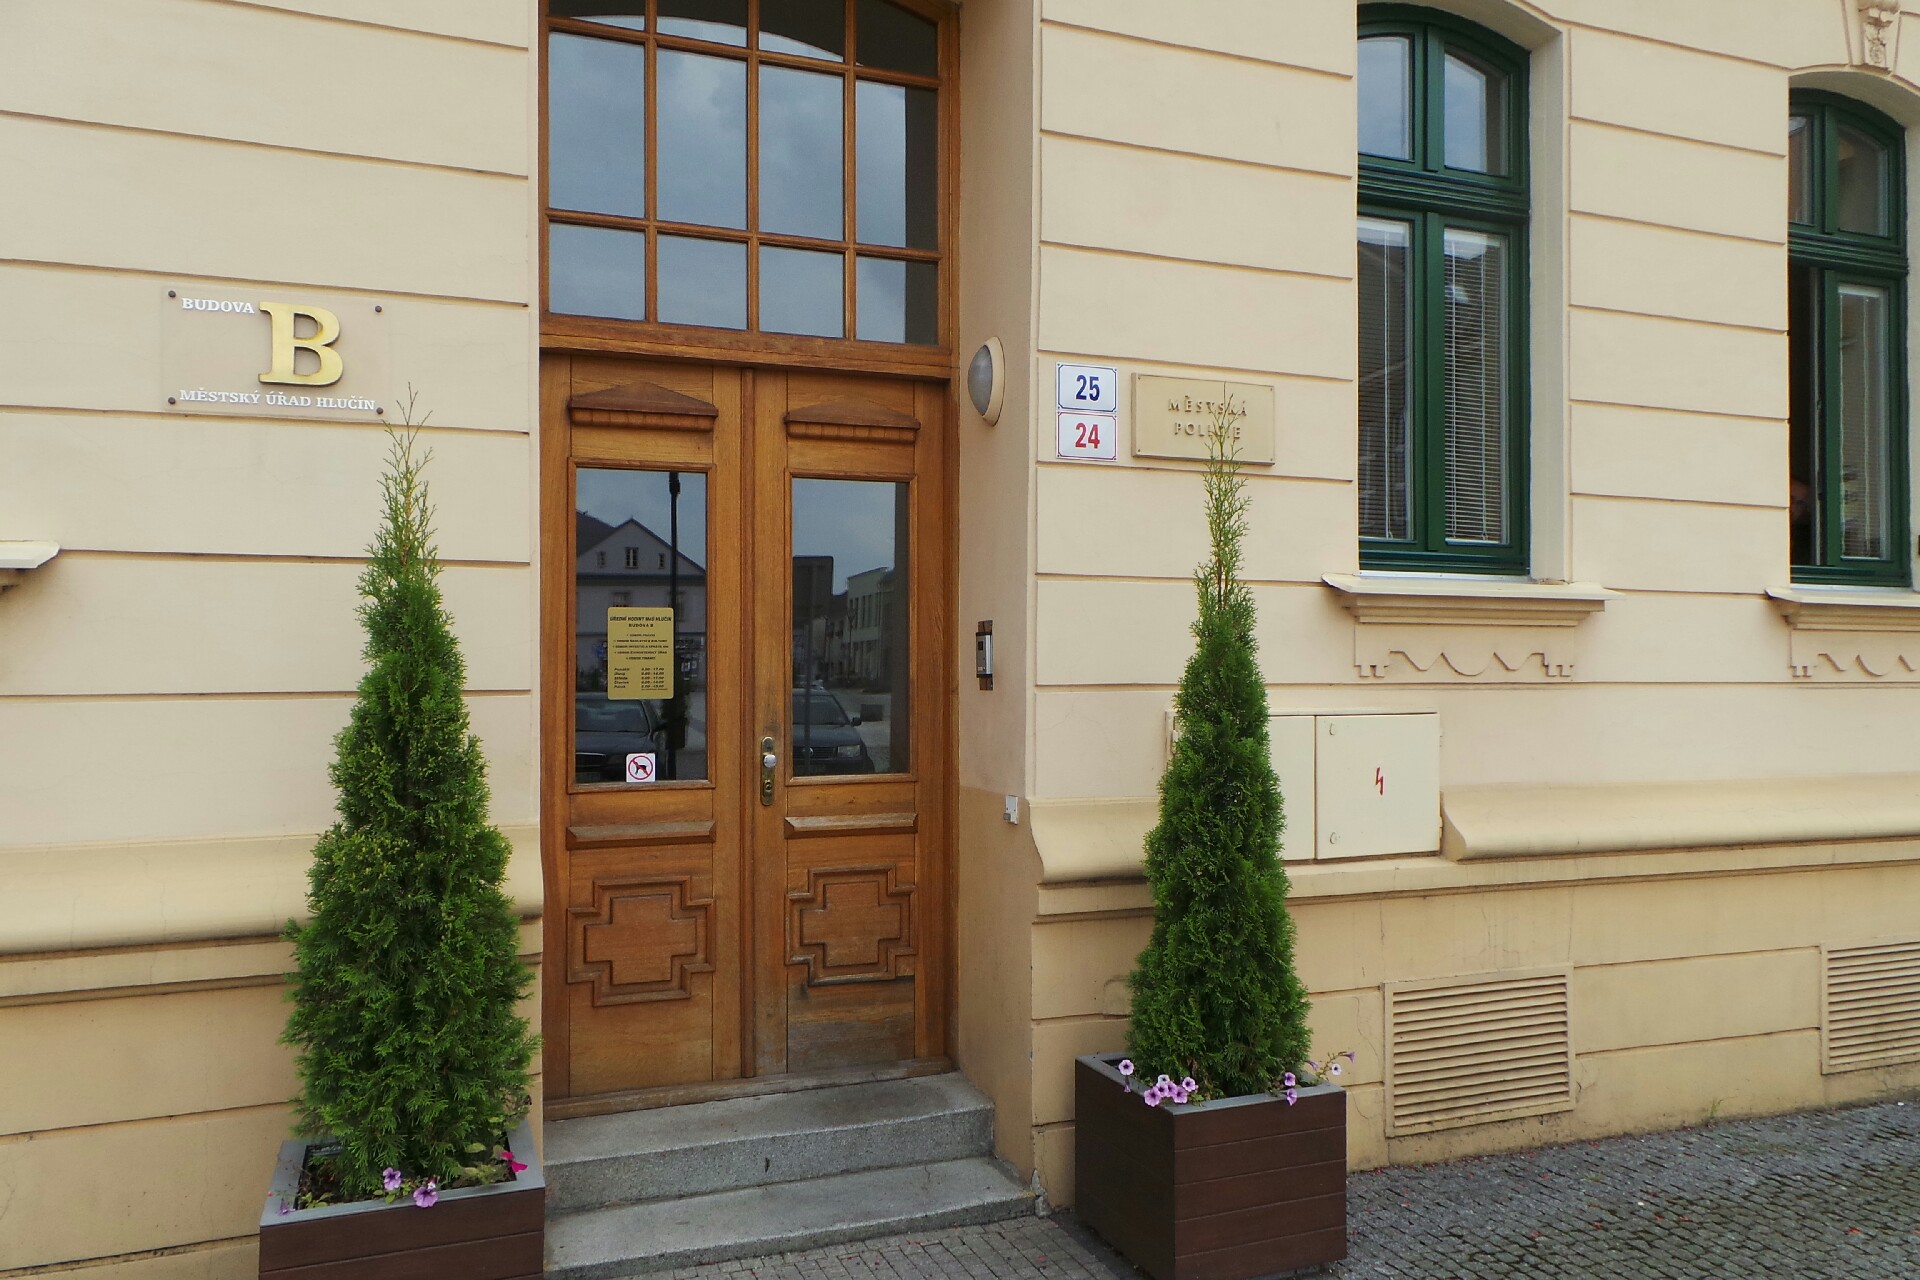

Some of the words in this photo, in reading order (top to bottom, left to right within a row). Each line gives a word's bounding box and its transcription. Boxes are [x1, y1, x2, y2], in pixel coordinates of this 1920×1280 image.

[182, 298, 255, 314] BUDOVA
[258, 301, 343, 387] B
[180, 388, 260, 404] MĚSTSKÝ
[266, 390, 311, 407] ÚŘAD
[316, 395, 376, 410] HLUČÍN
[1076, 374, 1100, 402] 25
[1168, 395, 1247, 416] MĚSTSKÁ
[1075, 422, 1100, 448] 24
[1174, 422, 1241, 440] POLIE
